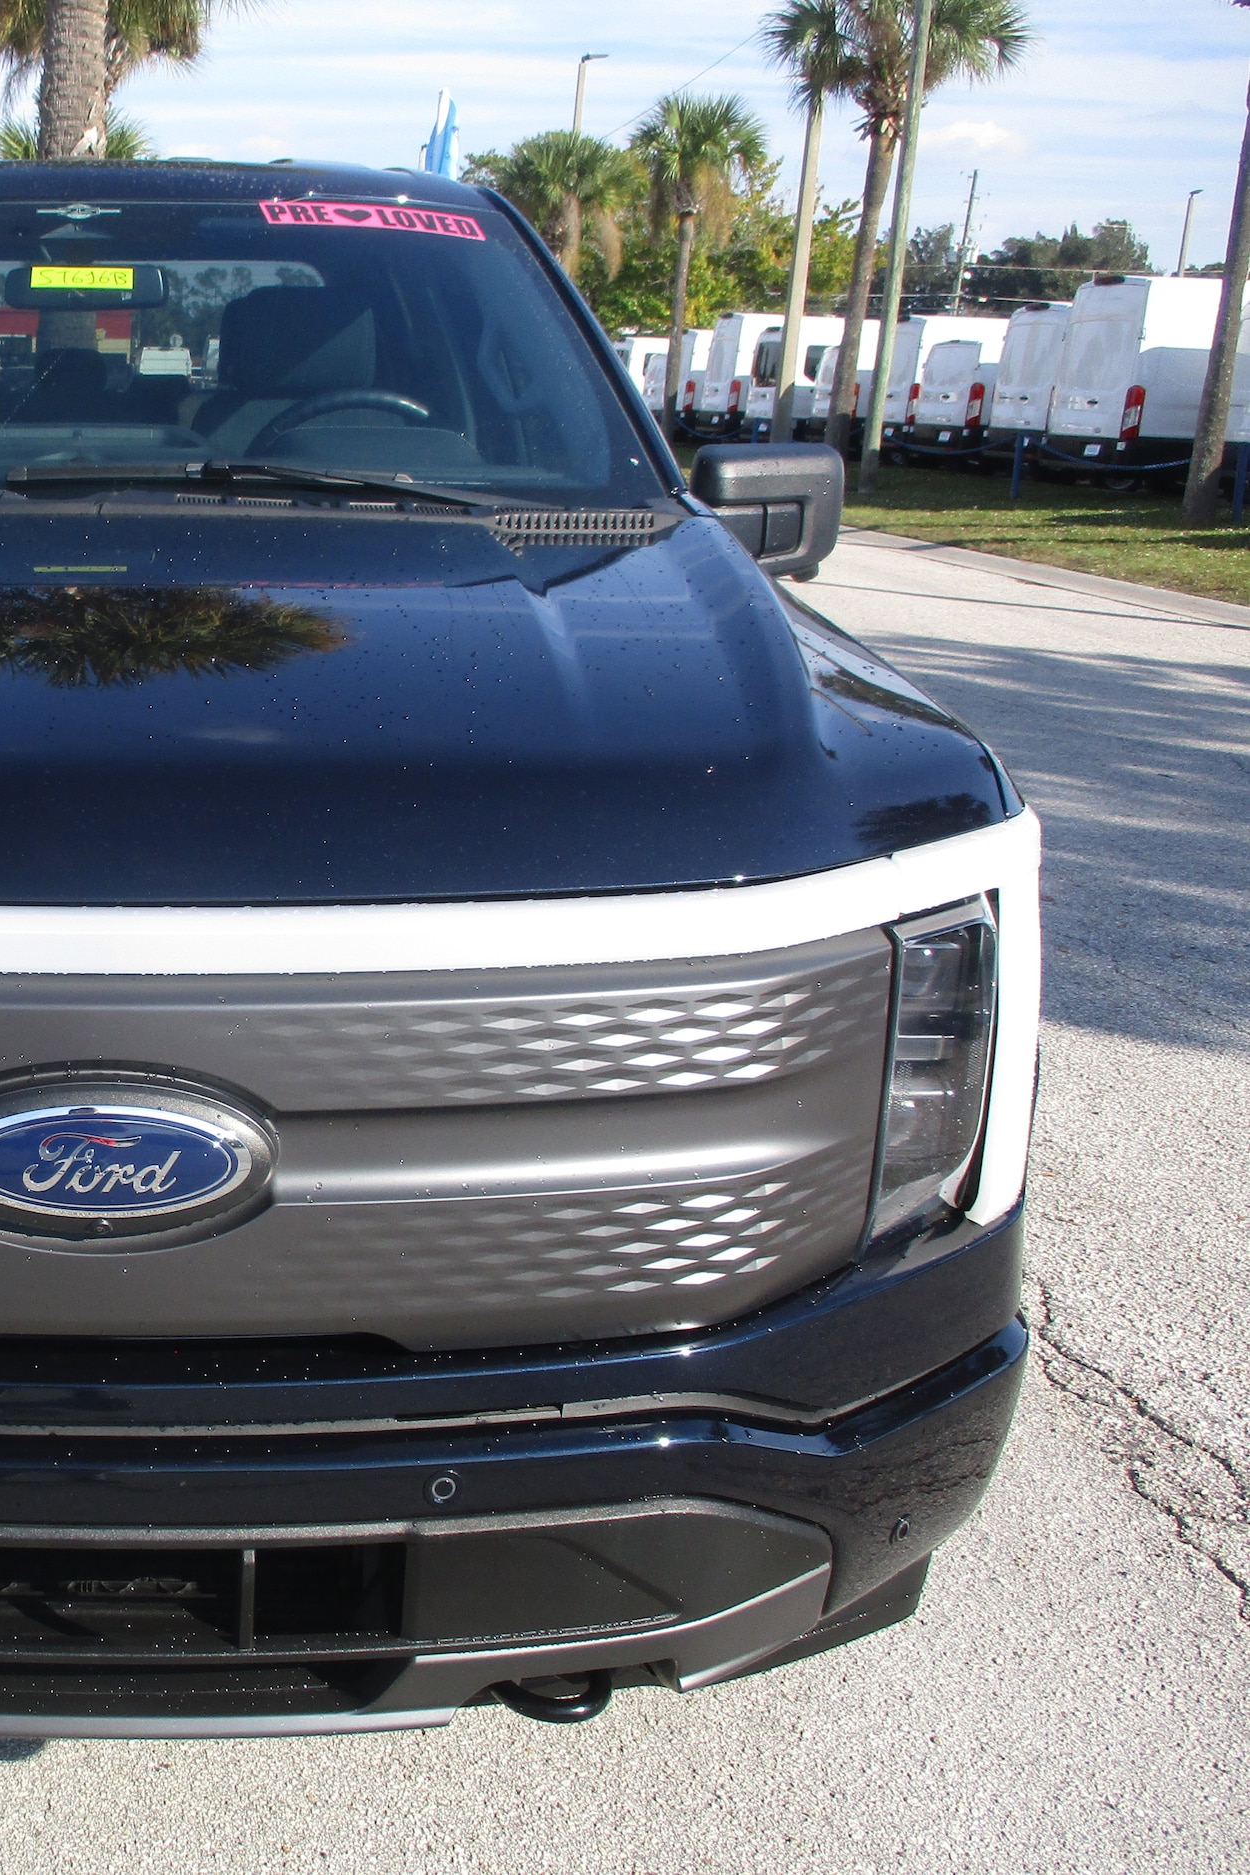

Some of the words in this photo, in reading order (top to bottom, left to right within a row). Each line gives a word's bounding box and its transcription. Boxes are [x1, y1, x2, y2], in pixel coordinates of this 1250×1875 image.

[264, 204, 333, 224] PRE
[376, 208, 479, 237] LOVED
[22, 1131, 182, 1194] Ford
